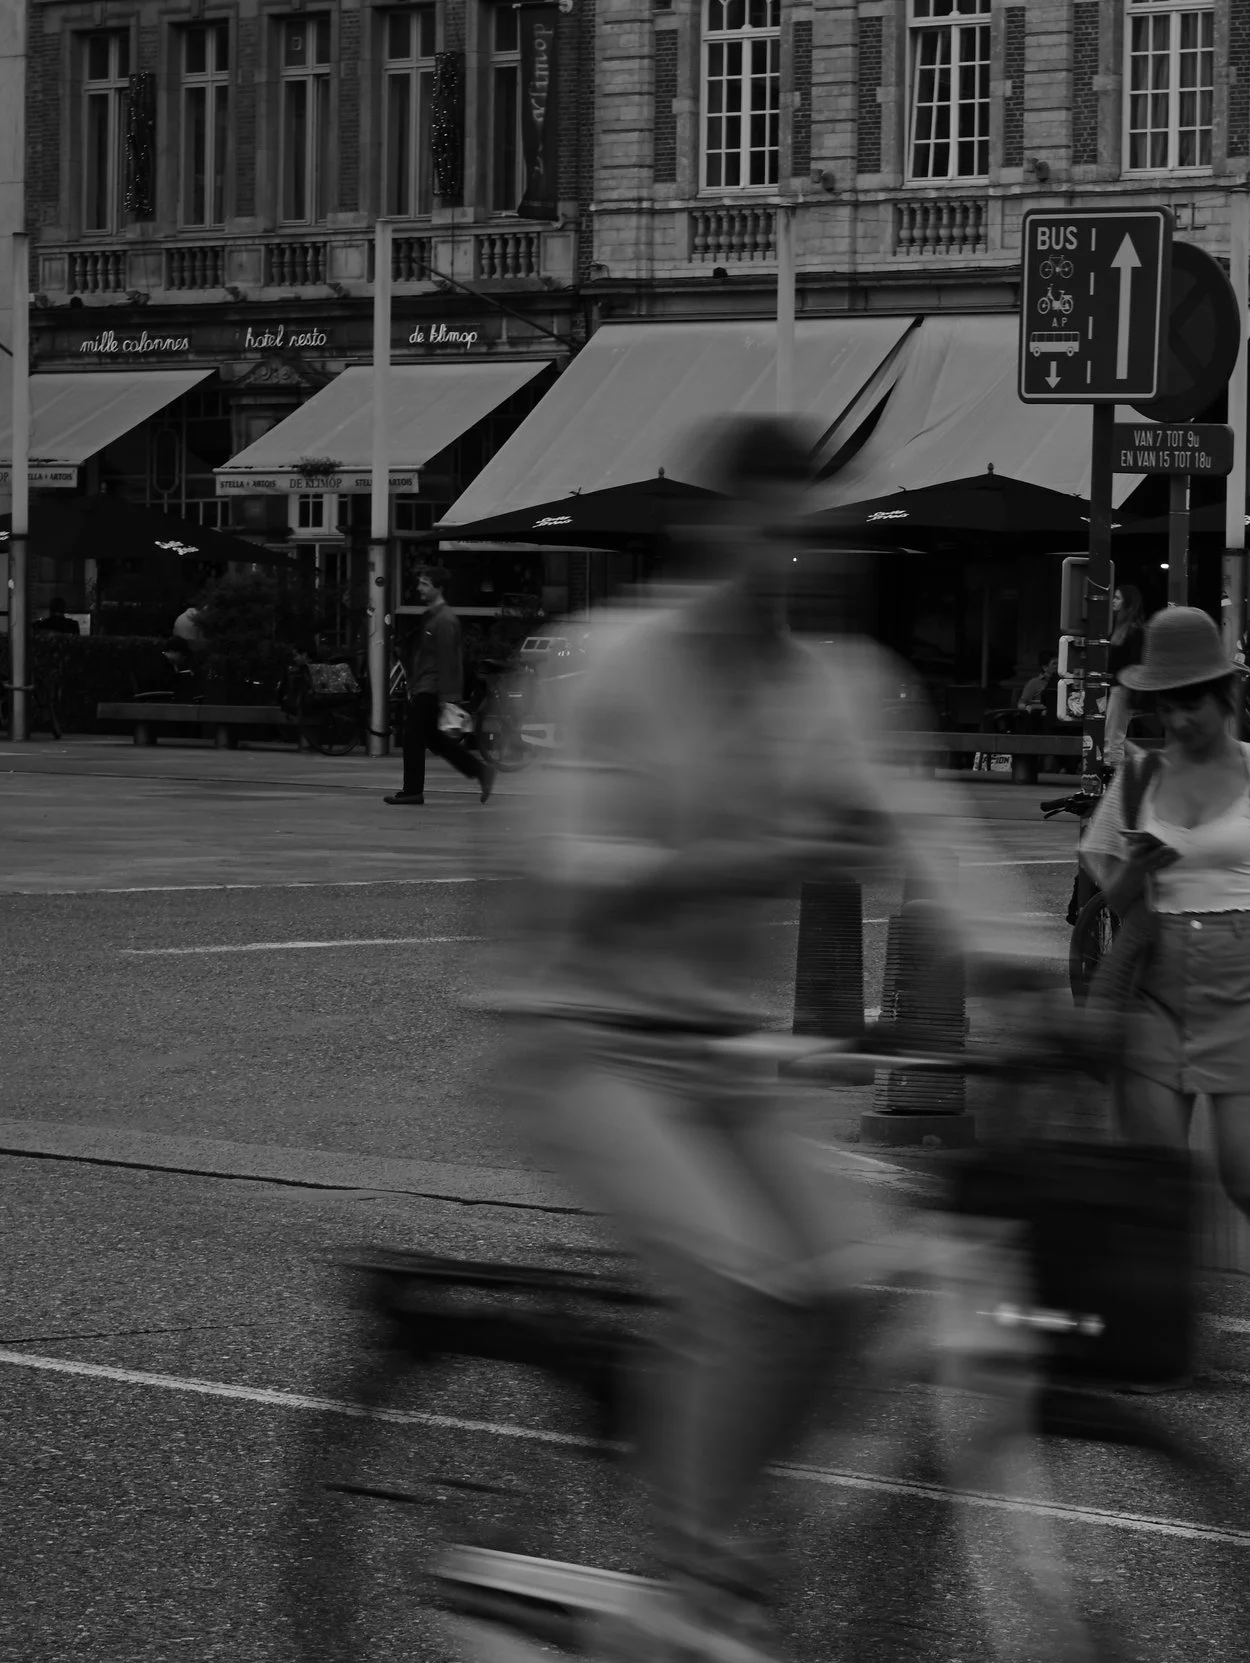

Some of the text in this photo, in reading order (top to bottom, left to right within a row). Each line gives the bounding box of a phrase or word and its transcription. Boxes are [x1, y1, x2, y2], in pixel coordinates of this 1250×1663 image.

[1036, 226, 1078, 250] BUS
[80, 329, 190, 353] mille colonnes
[245, 324, 327, 349] hotel resto
[408, 323, 478, 350] de klimop
[1133, 430, 1200, 448] VAN 7 TOT 9u
[1120, 450, 1212, 469] EN VAN 15 TOT 18u
[220, 479, 277, 489] STELLA ARTOIS
[289, 478, 342, 489] DE KLIMOP
[354, 478, 373, 487] STEL
